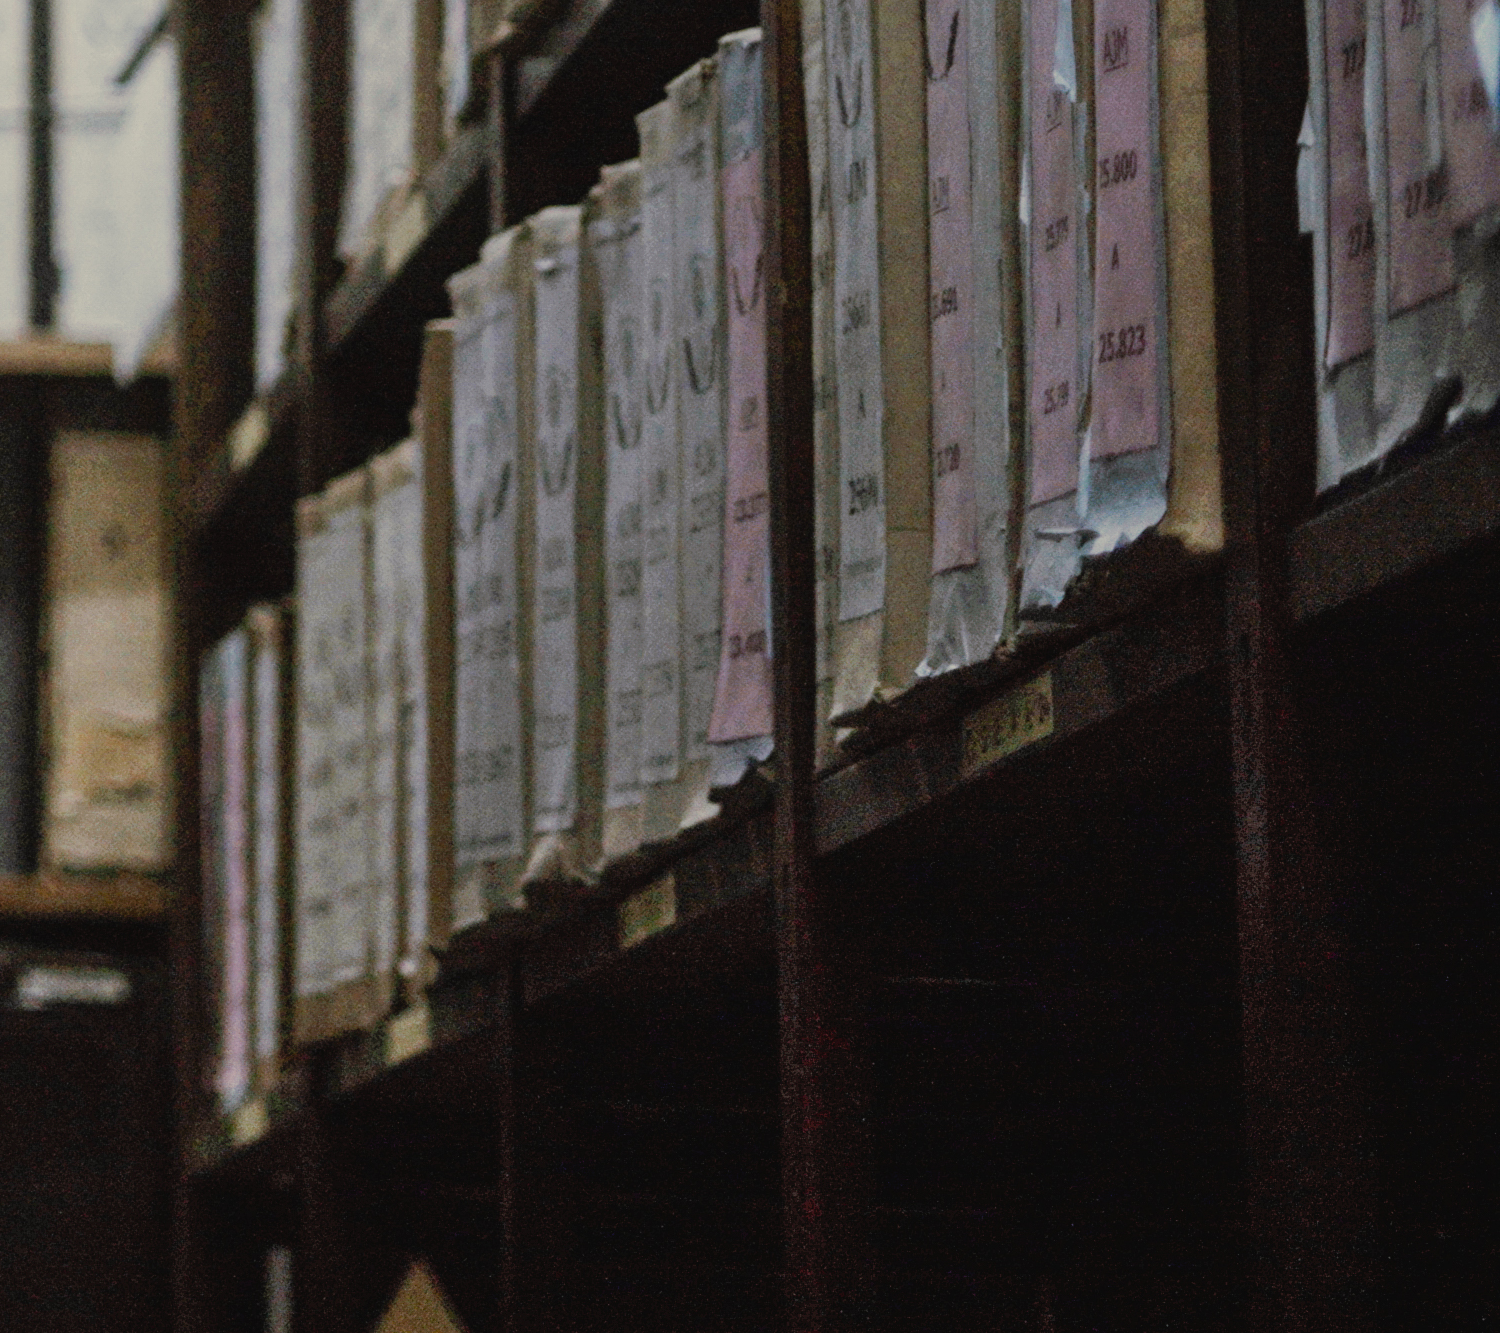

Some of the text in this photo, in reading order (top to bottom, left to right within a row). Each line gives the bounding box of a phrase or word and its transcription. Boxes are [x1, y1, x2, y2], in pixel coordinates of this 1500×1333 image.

[1104, 25, 1130, 66] AJM
[1111, 241, 1120, 271] A
[1099, 324, 1147, 365] 25.823
